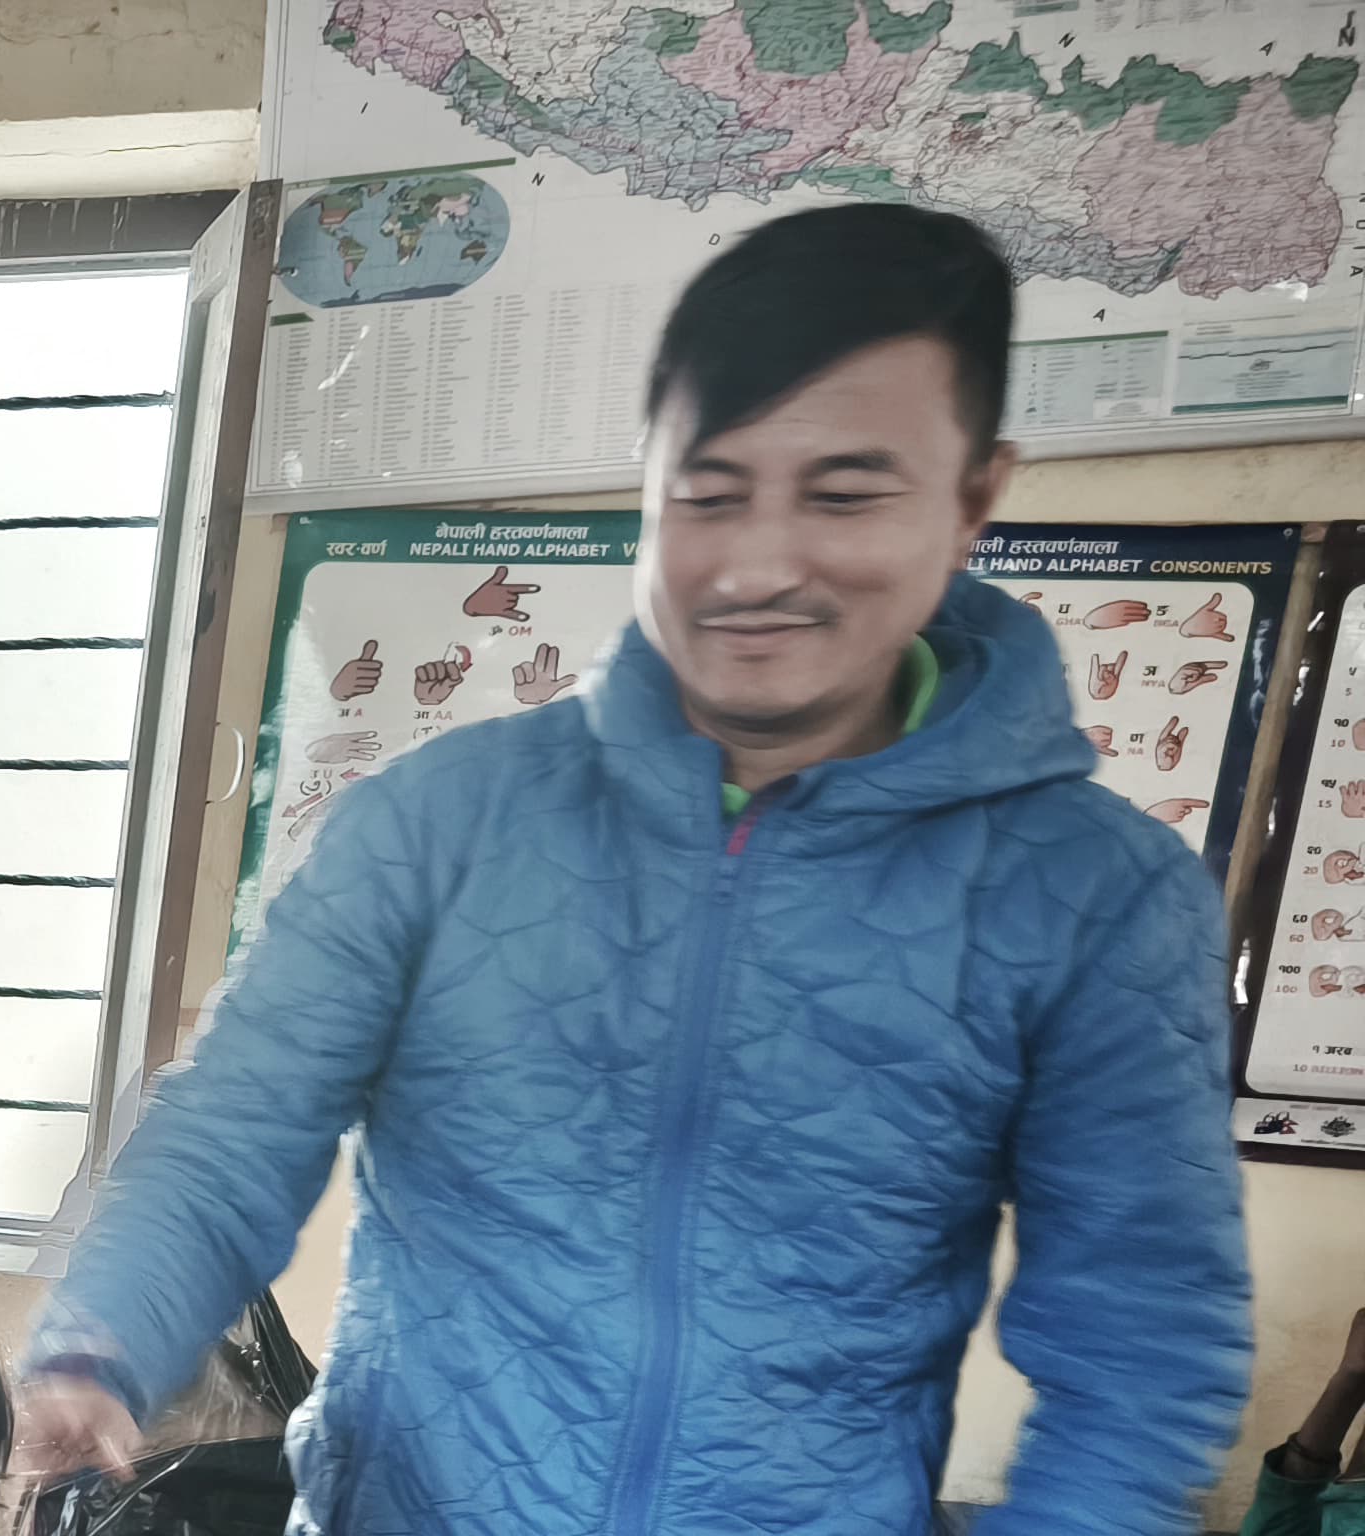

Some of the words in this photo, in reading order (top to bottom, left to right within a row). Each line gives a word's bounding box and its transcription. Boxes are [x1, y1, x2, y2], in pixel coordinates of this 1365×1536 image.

[410, 543, 469, 556] NEPALI
[474, 543, 519, 557] HAND
[524, 543, 610, 558] ALPHABET
[989, 557, 1042, 572] HAND
[1046, 558, 1142, 574] ALPHABET
[1150, 560, 1272, 575] CONSONENTS
[508, 626, 532, 636] OM
[434, 710, 453, 721] AA
